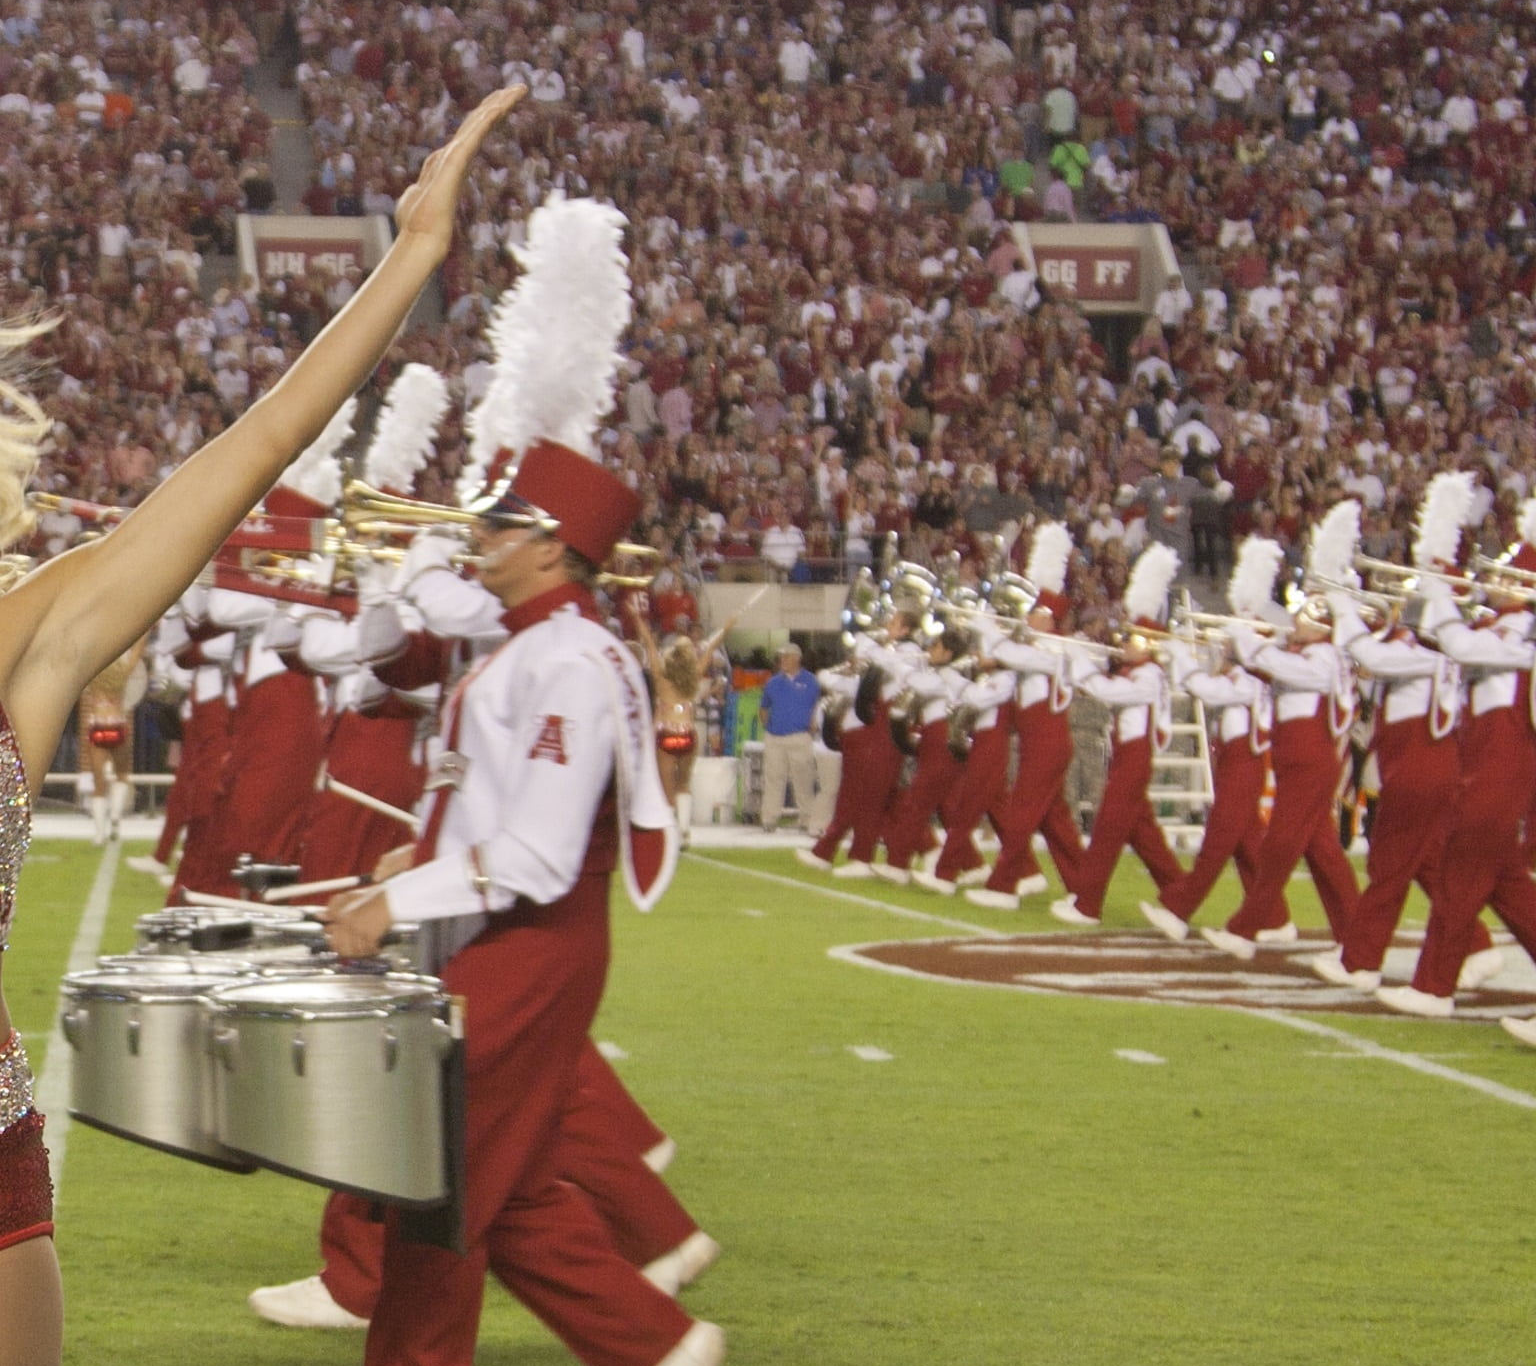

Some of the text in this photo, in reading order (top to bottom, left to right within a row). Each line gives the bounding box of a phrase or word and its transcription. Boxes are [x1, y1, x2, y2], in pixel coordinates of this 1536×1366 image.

[266, 251, 306, 276] HH
[1040, 258, 1132, 285] GG FF
[527, 715, 570, 766] A
